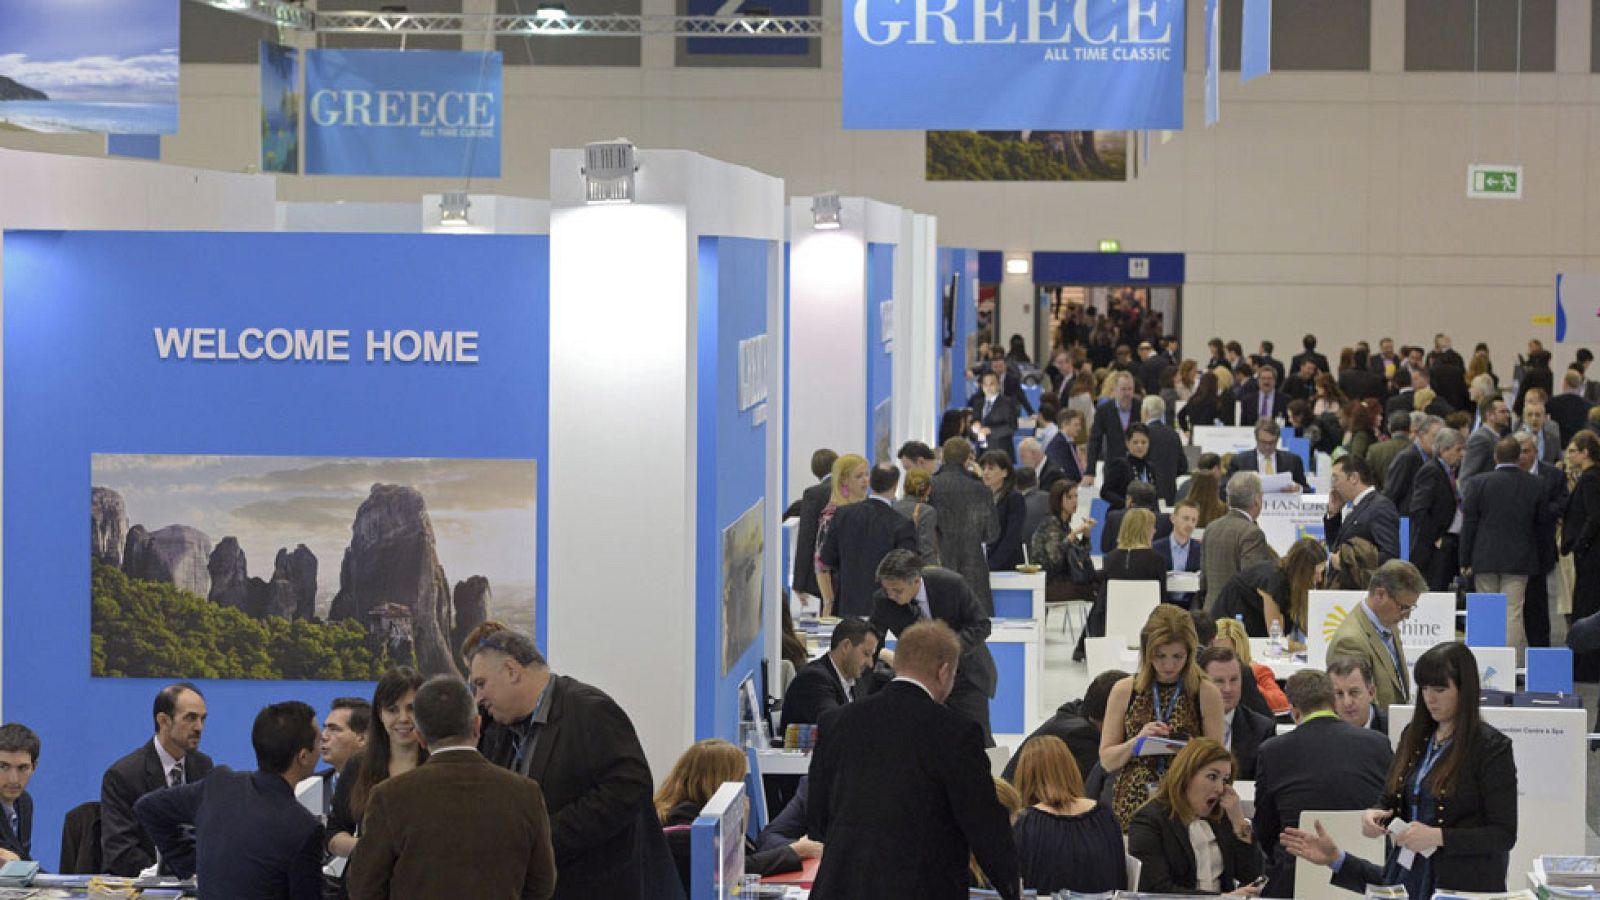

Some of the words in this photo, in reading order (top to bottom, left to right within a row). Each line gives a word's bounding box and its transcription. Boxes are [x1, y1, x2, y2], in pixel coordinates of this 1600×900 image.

[853, 0, 1173, 45] GREECE
[1045, 47, 1069, 60] ALL
[1074, 48, 1108, 60] TIME
[1112, 47, 1171, 61] CLASSIC
[309, 89, 495, 128] GREECE
[154, 327, 350, 361] WELCOME
[366, 330, 479, 363] HOME
